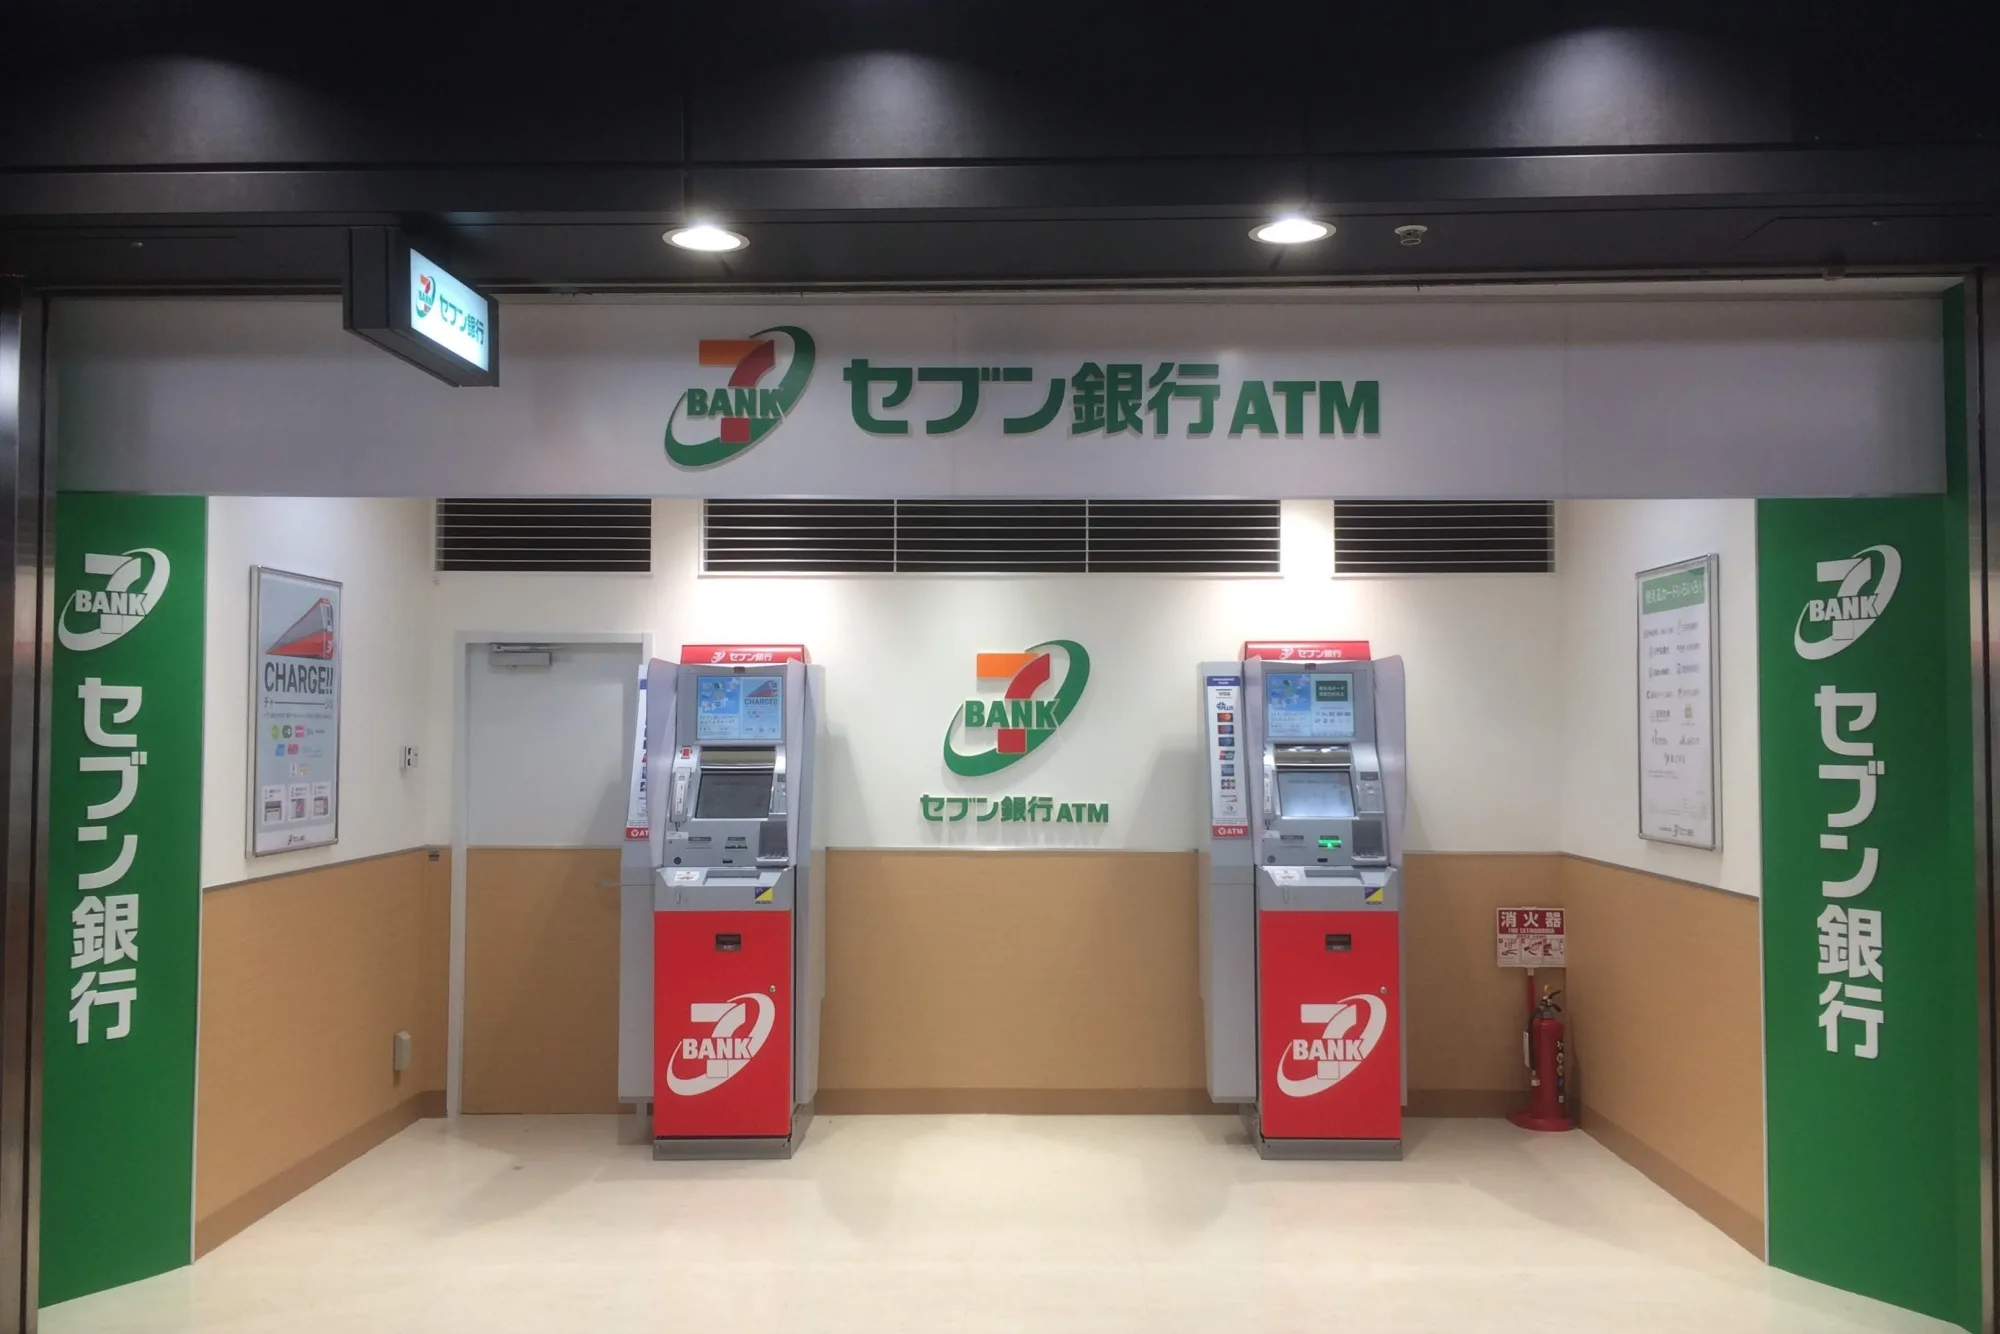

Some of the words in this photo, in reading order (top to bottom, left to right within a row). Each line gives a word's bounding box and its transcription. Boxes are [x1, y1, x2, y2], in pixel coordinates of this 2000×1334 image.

[686, 387, 786, 420] BANK
[843, 358, 1220, 436] セブン銀行
[1228, 380, 1381, 435] ATM
[75, 589, 148, 617] BANK
[1809, 594, 1881, 622] BANK
[264, 661, 335, 695] CHARGE!!
[965, 700, 1058, 729] BANK
[920, 795, 1054, 822] セブン銀行
[1056, 803, 1109, 823] ATM
[69, 677, 147, 1045] セブン銀行
[1814, 685, 1886, 1060] セブン銀行
[1501, 911, 1561, 928] 消火器
[682, 1038, 752, 1060] BANK
[1293, 1039, 1363, 1061] BANK
